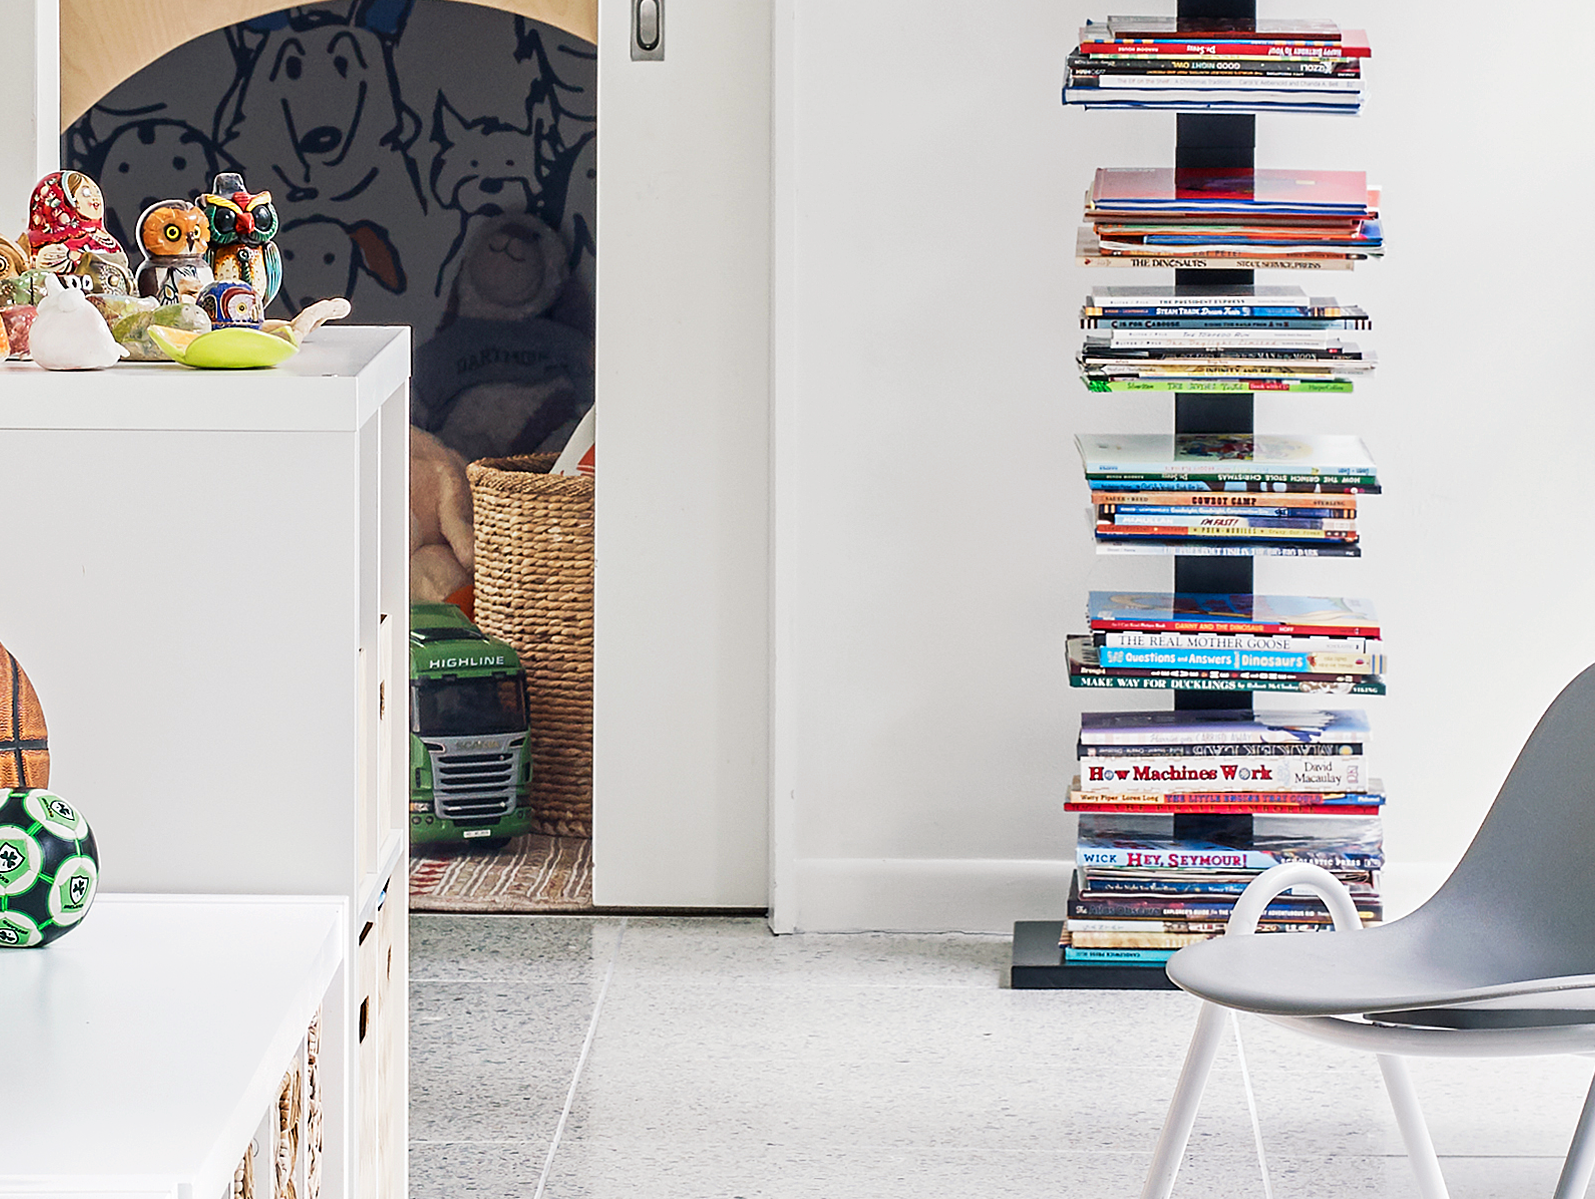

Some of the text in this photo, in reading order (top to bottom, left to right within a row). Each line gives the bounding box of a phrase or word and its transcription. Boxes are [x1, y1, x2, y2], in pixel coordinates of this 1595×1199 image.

[1172, 61, 1190, 69] OWL
[1191, 61, 1215, 69] NIGHT
[1131, 259, 1206, 267] THE DINOSAURS
[1192, 497, 1228, 505] COWBOY
[1231, 497, 1256, 505] CAMP
[1119, 636, 1290, 649] THE REAL MOTHER GOOSE
[429, 655, 504, 669] HIGHLINE
[1126, 652, 1175, 663] Questions
[1189, 654, 1232, 664] Answers
[1242, 655, 1303, 667] Dinosaurs
[1081, 678, 1113, 686] MAKE
[1117, 679, 1140, 687] WAY
[1143, 679, 1166, 687] FOR
[1171, 680, 1236, 689] DUCKLINGS
[1193, 745, 1332, 756] MAKER LAB
[1304, 761, 1332, 772] David
[1088, 767, 1130, 780] How
[1133, 765, 1217, 781] Machines
[1220, 765, 1272, 780] Work
[1295, 773, 1341, 785] Macaulay
[1084, 853, 1361, 867] WICK HEY, SEYMOUR! PRESS
[1076, 905, 1087, 914] The
